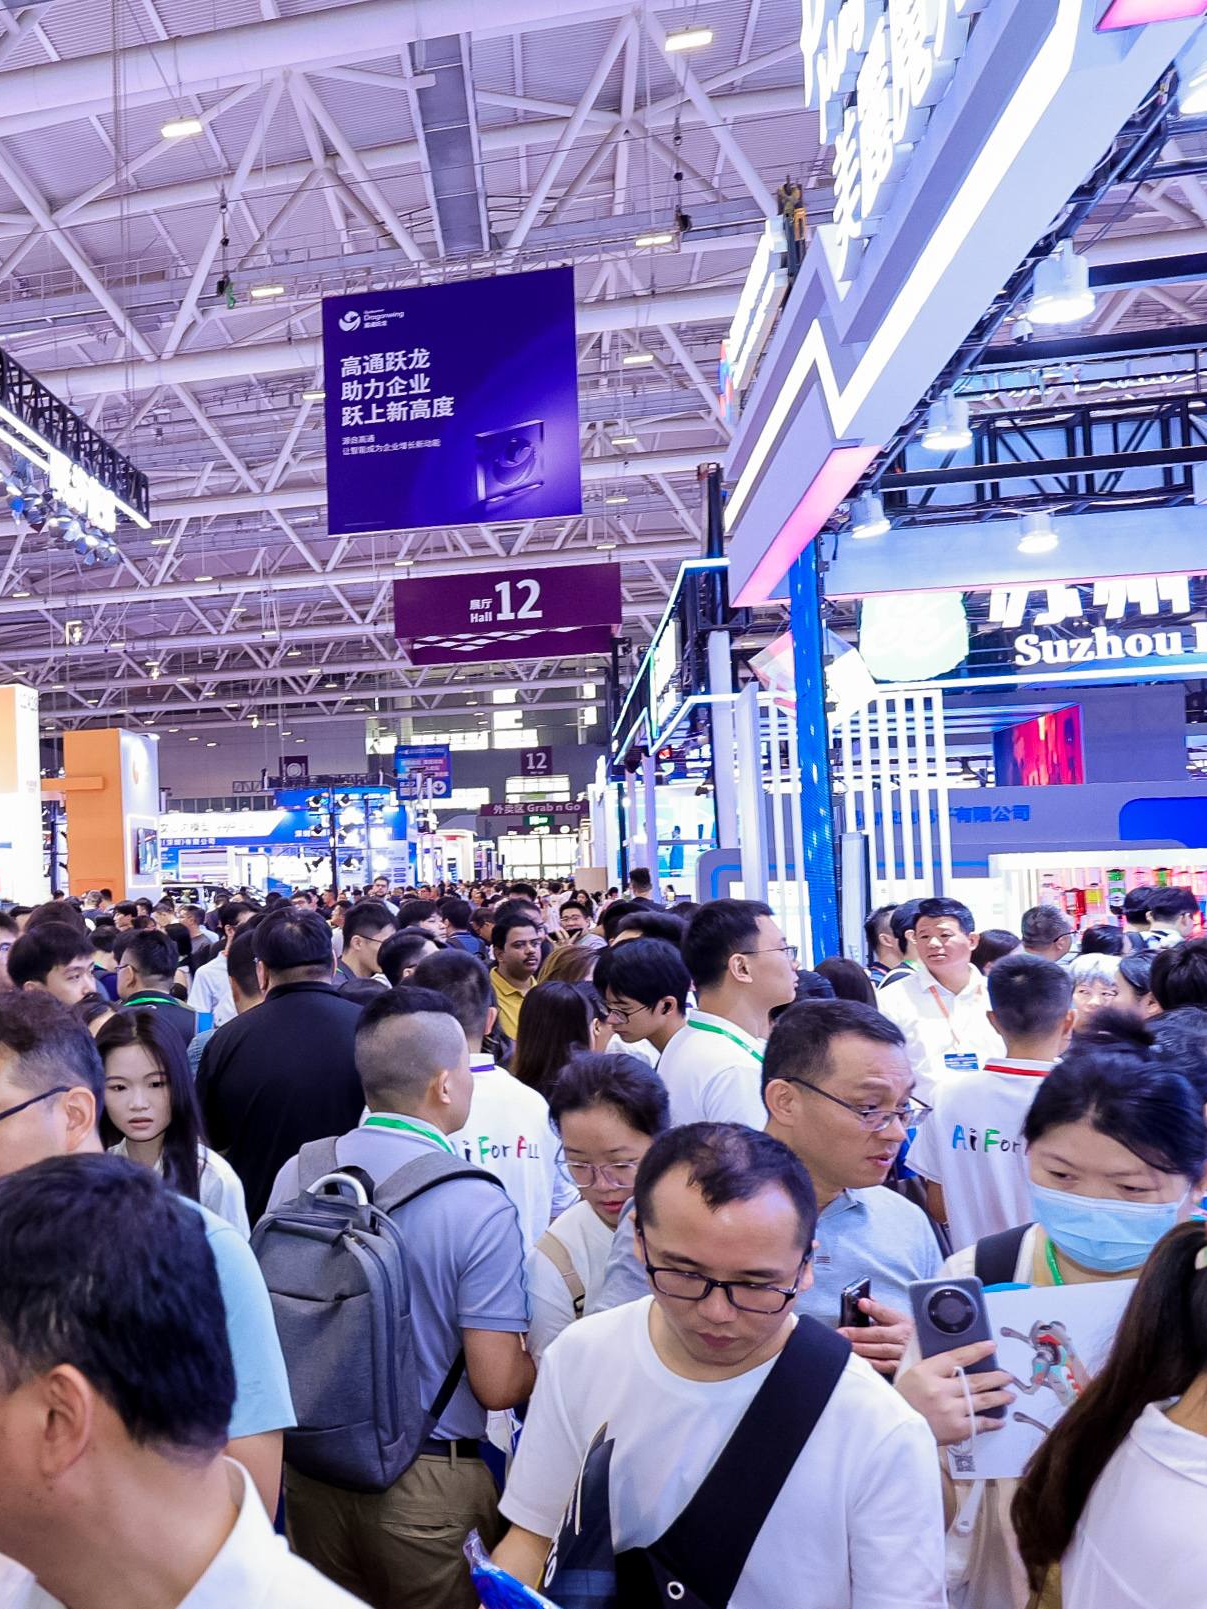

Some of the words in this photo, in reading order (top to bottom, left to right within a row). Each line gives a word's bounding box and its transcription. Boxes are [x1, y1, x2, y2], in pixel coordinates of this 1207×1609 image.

[340, 348, 431, 377] 高通跃龙
[340, 373, 431, 401] 助力企业
[340, 395, 455, 427] 跃上新高度
[469, 598, 493, 610] 展厅
[470, 611, 493, 624] Hall
[495, 579, 543, 621] 12
[1014, 626, 1184, 667] Suzhou
[526, 752, 548, 770] 12
[494, 804, 525, 814] 外卖区
[527, 803, 554, 813] Grab
[556, 804, 563, 812] n
[565, 802, 581, 811] Go
[478, 1136, 511, 1164] For
[952, 1124, 977, 1152] Ai
[984, 1128, 1022, 1153] For
